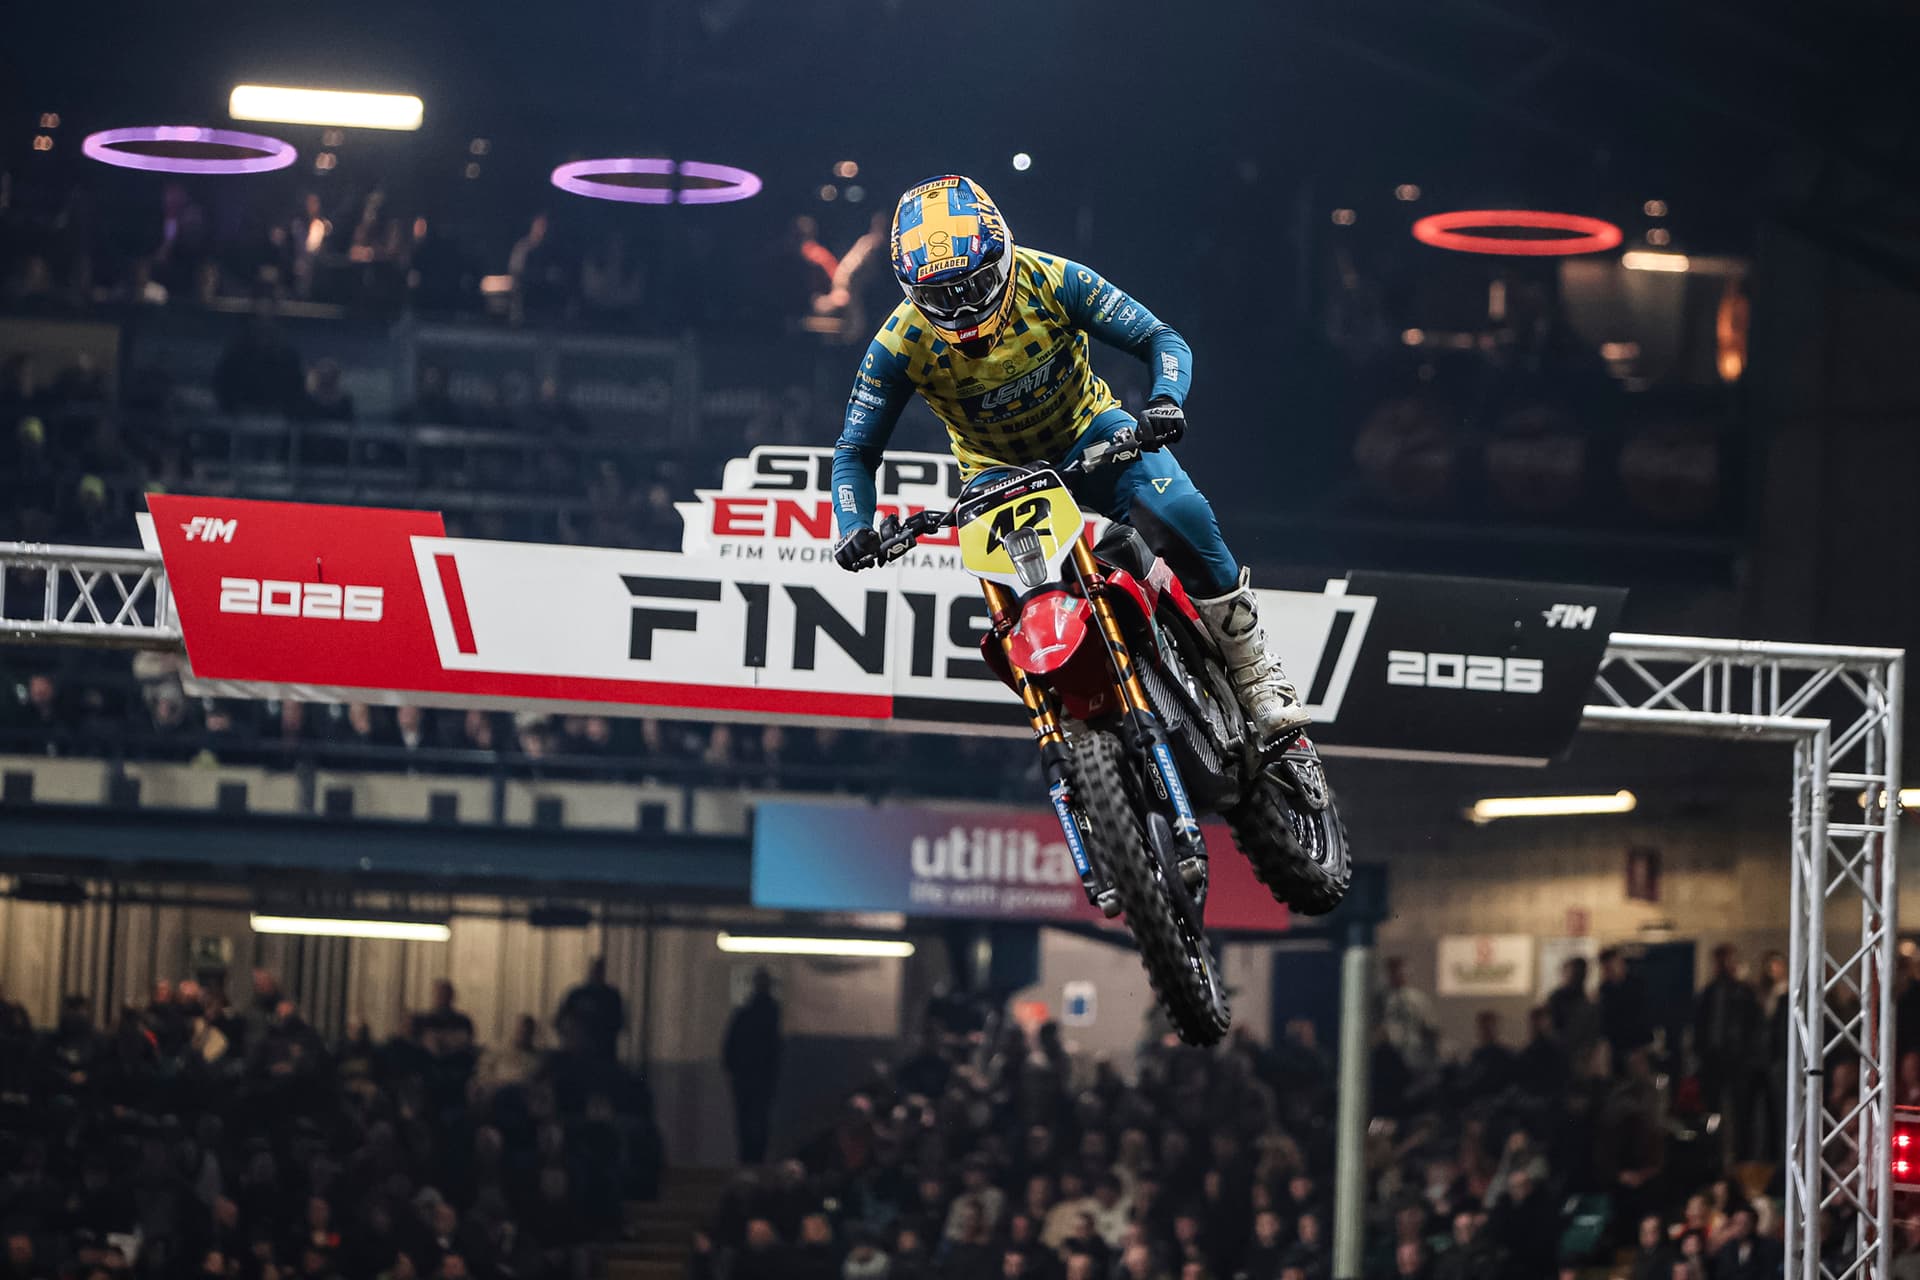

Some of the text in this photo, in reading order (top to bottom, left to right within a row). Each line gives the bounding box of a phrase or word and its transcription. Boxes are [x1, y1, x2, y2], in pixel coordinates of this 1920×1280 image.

[982, 357, 1056, 409] LEATT
[181, 516, 237, 543] FIM
[986, 497, 1052, 555] 42
[719, 543, 763, 560] FIM
[779, 546, 834, 563] WOR
[220, 577, 384, 622] 2026
[1542, 604, 1597, 629] FIM
[619, 574, 1001, 682] FINIS
[1387, 650, 1543, 693] 2026
[912, 826, 1074, 884] utilita
